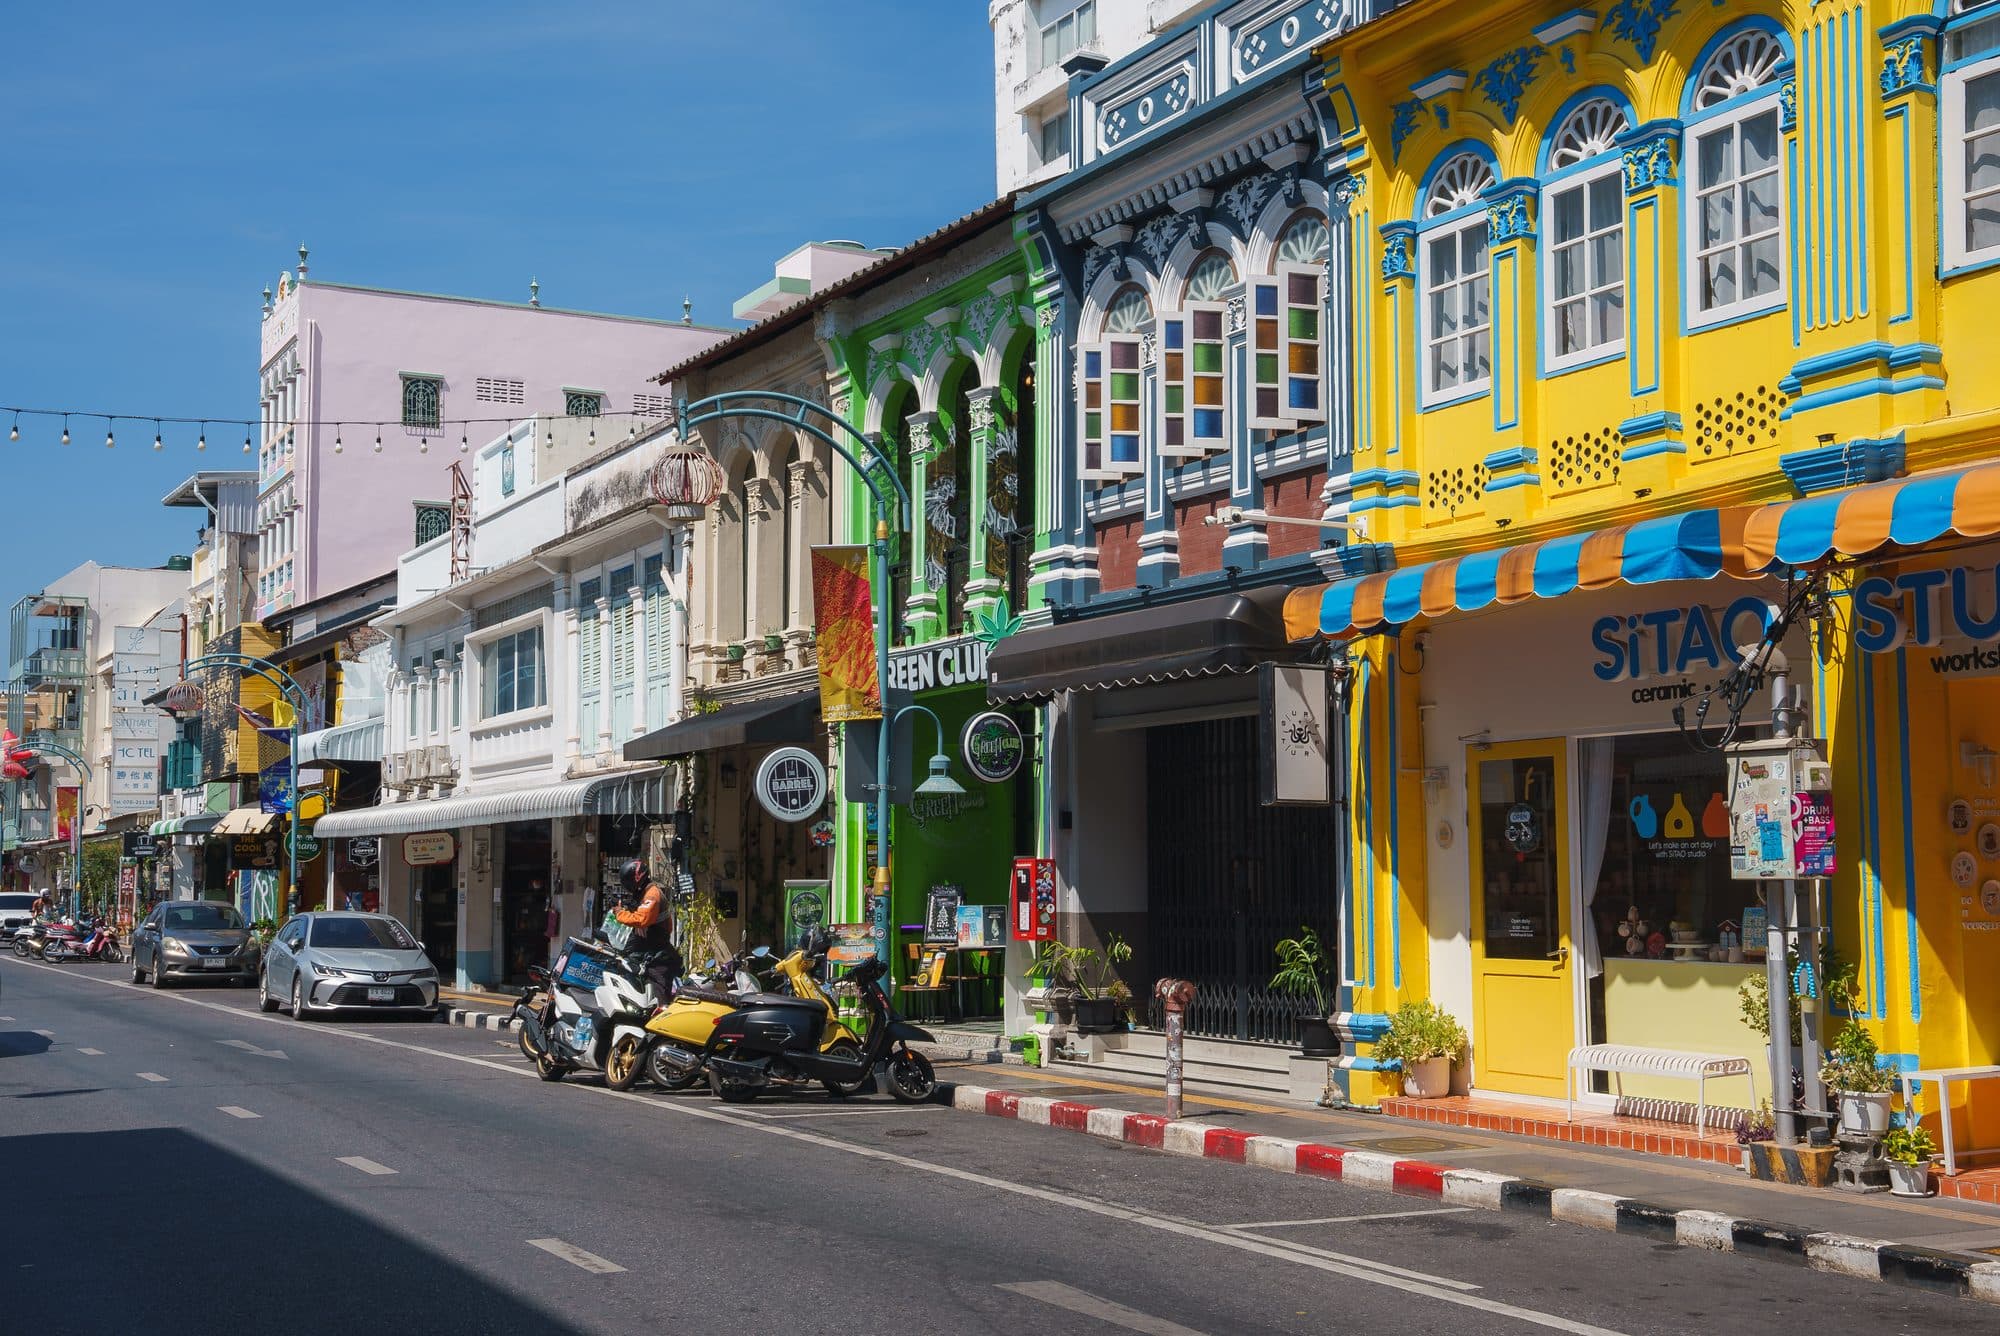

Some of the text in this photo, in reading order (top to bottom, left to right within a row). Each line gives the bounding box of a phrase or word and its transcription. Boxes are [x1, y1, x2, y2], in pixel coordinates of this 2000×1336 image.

[877, 652, 934, 691] REEN
[1631, 678, 1697, 703] ceramic
[772, 778, 813, 791] BARREL
[1802, 805, 1830, 815] DRUM
[1803, 816, 1830, 825] +BASS
